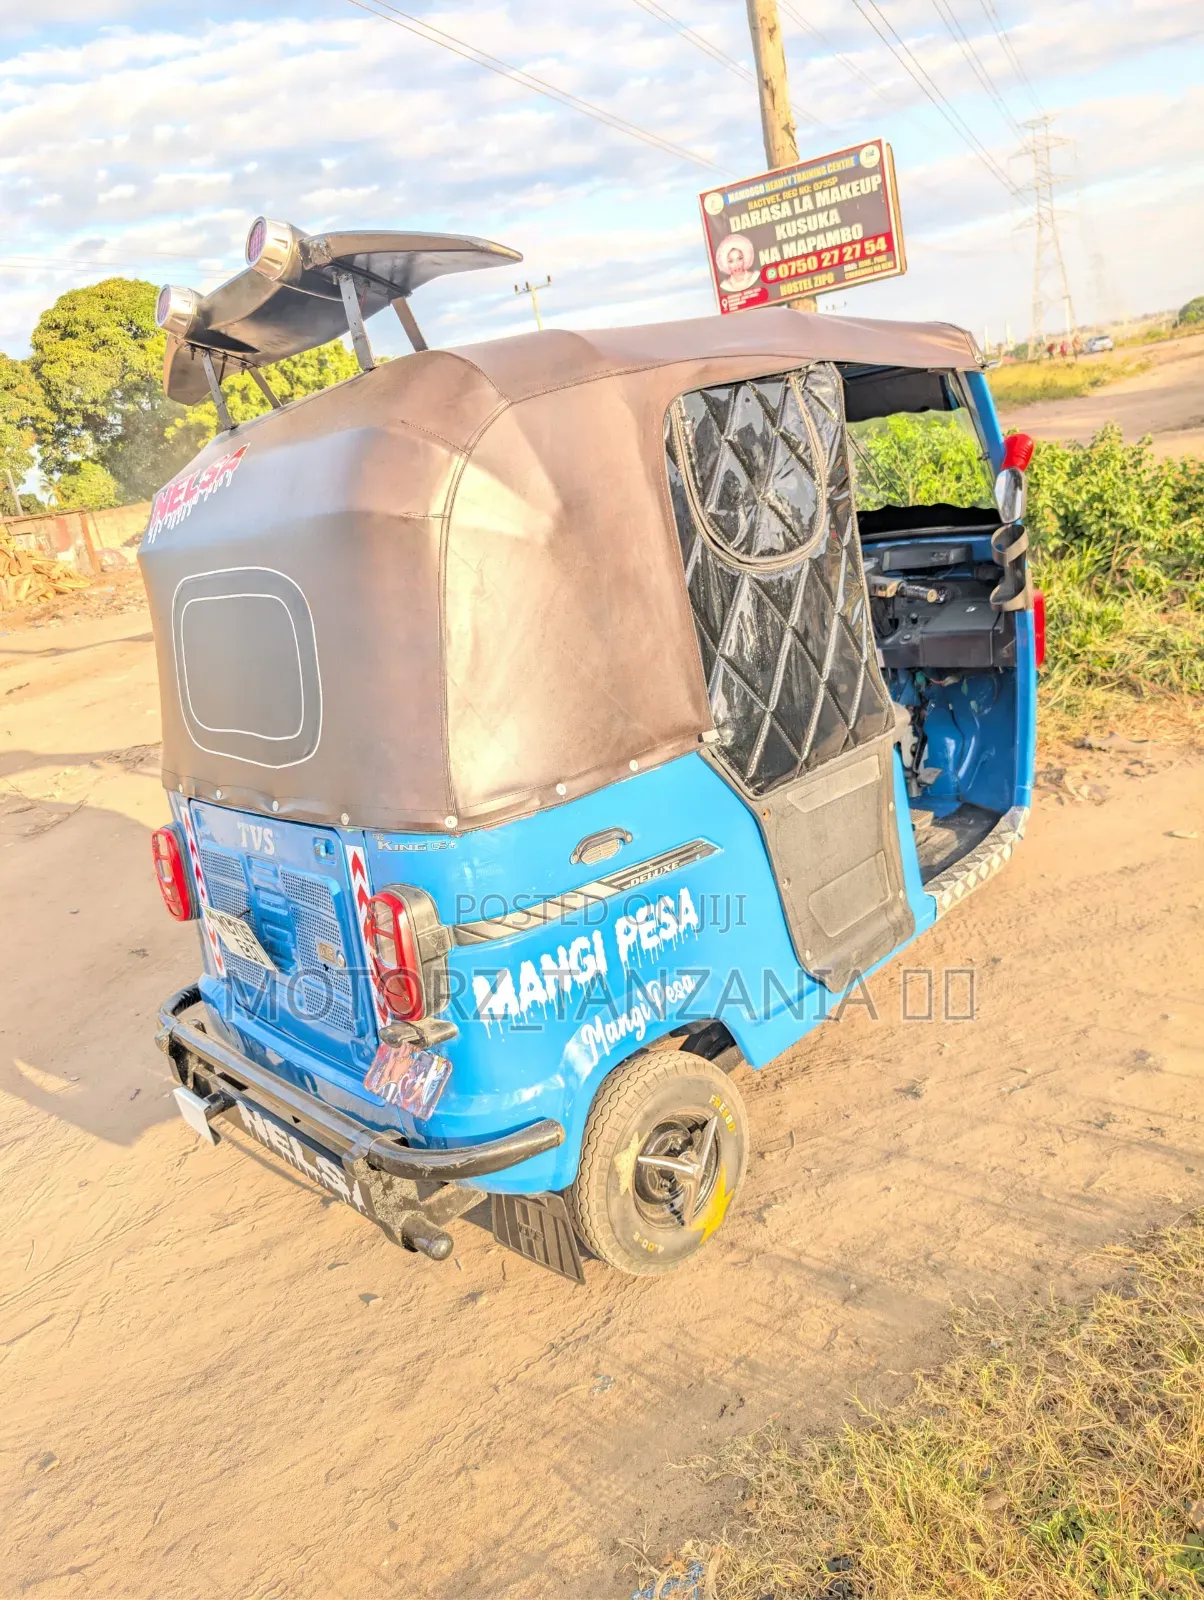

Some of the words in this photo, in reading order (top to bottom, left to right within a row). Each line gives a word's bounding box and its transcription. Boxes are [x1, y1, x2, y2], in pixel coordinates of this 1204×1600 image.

[792, 165, 827, 184] TRAINING
[827, 156, 855, 173] CENTRE
[729, 199, 792, 232] DARASA
[794, 194, 814, 212] LA
[815, 175, 882, 208] MAKEUP
[775, 208, 841, 240] KUSUKA
[759, 246, 781, 266] NA
[782, 224, 864, 260] MAPAMBO
[778, 255, 818, 278] 0750
[821, 249, 839, 267] 27
[842, 243, 861, 261] 27
[864, 236, 887, 255] 54
[780, 278, 813, 296] HOSTEL
[813, 271, 835, 287] ZIPO
[236, 821, 275, 856] TVS
[630, 860, 681, 888] DELUXE
[472, 929, 609, 1039] MANGI
[614, 887, 699, 980] PESA
[581, 990, 650, 1057] Mangi
[649, 974, 697, 1014] Pesa
